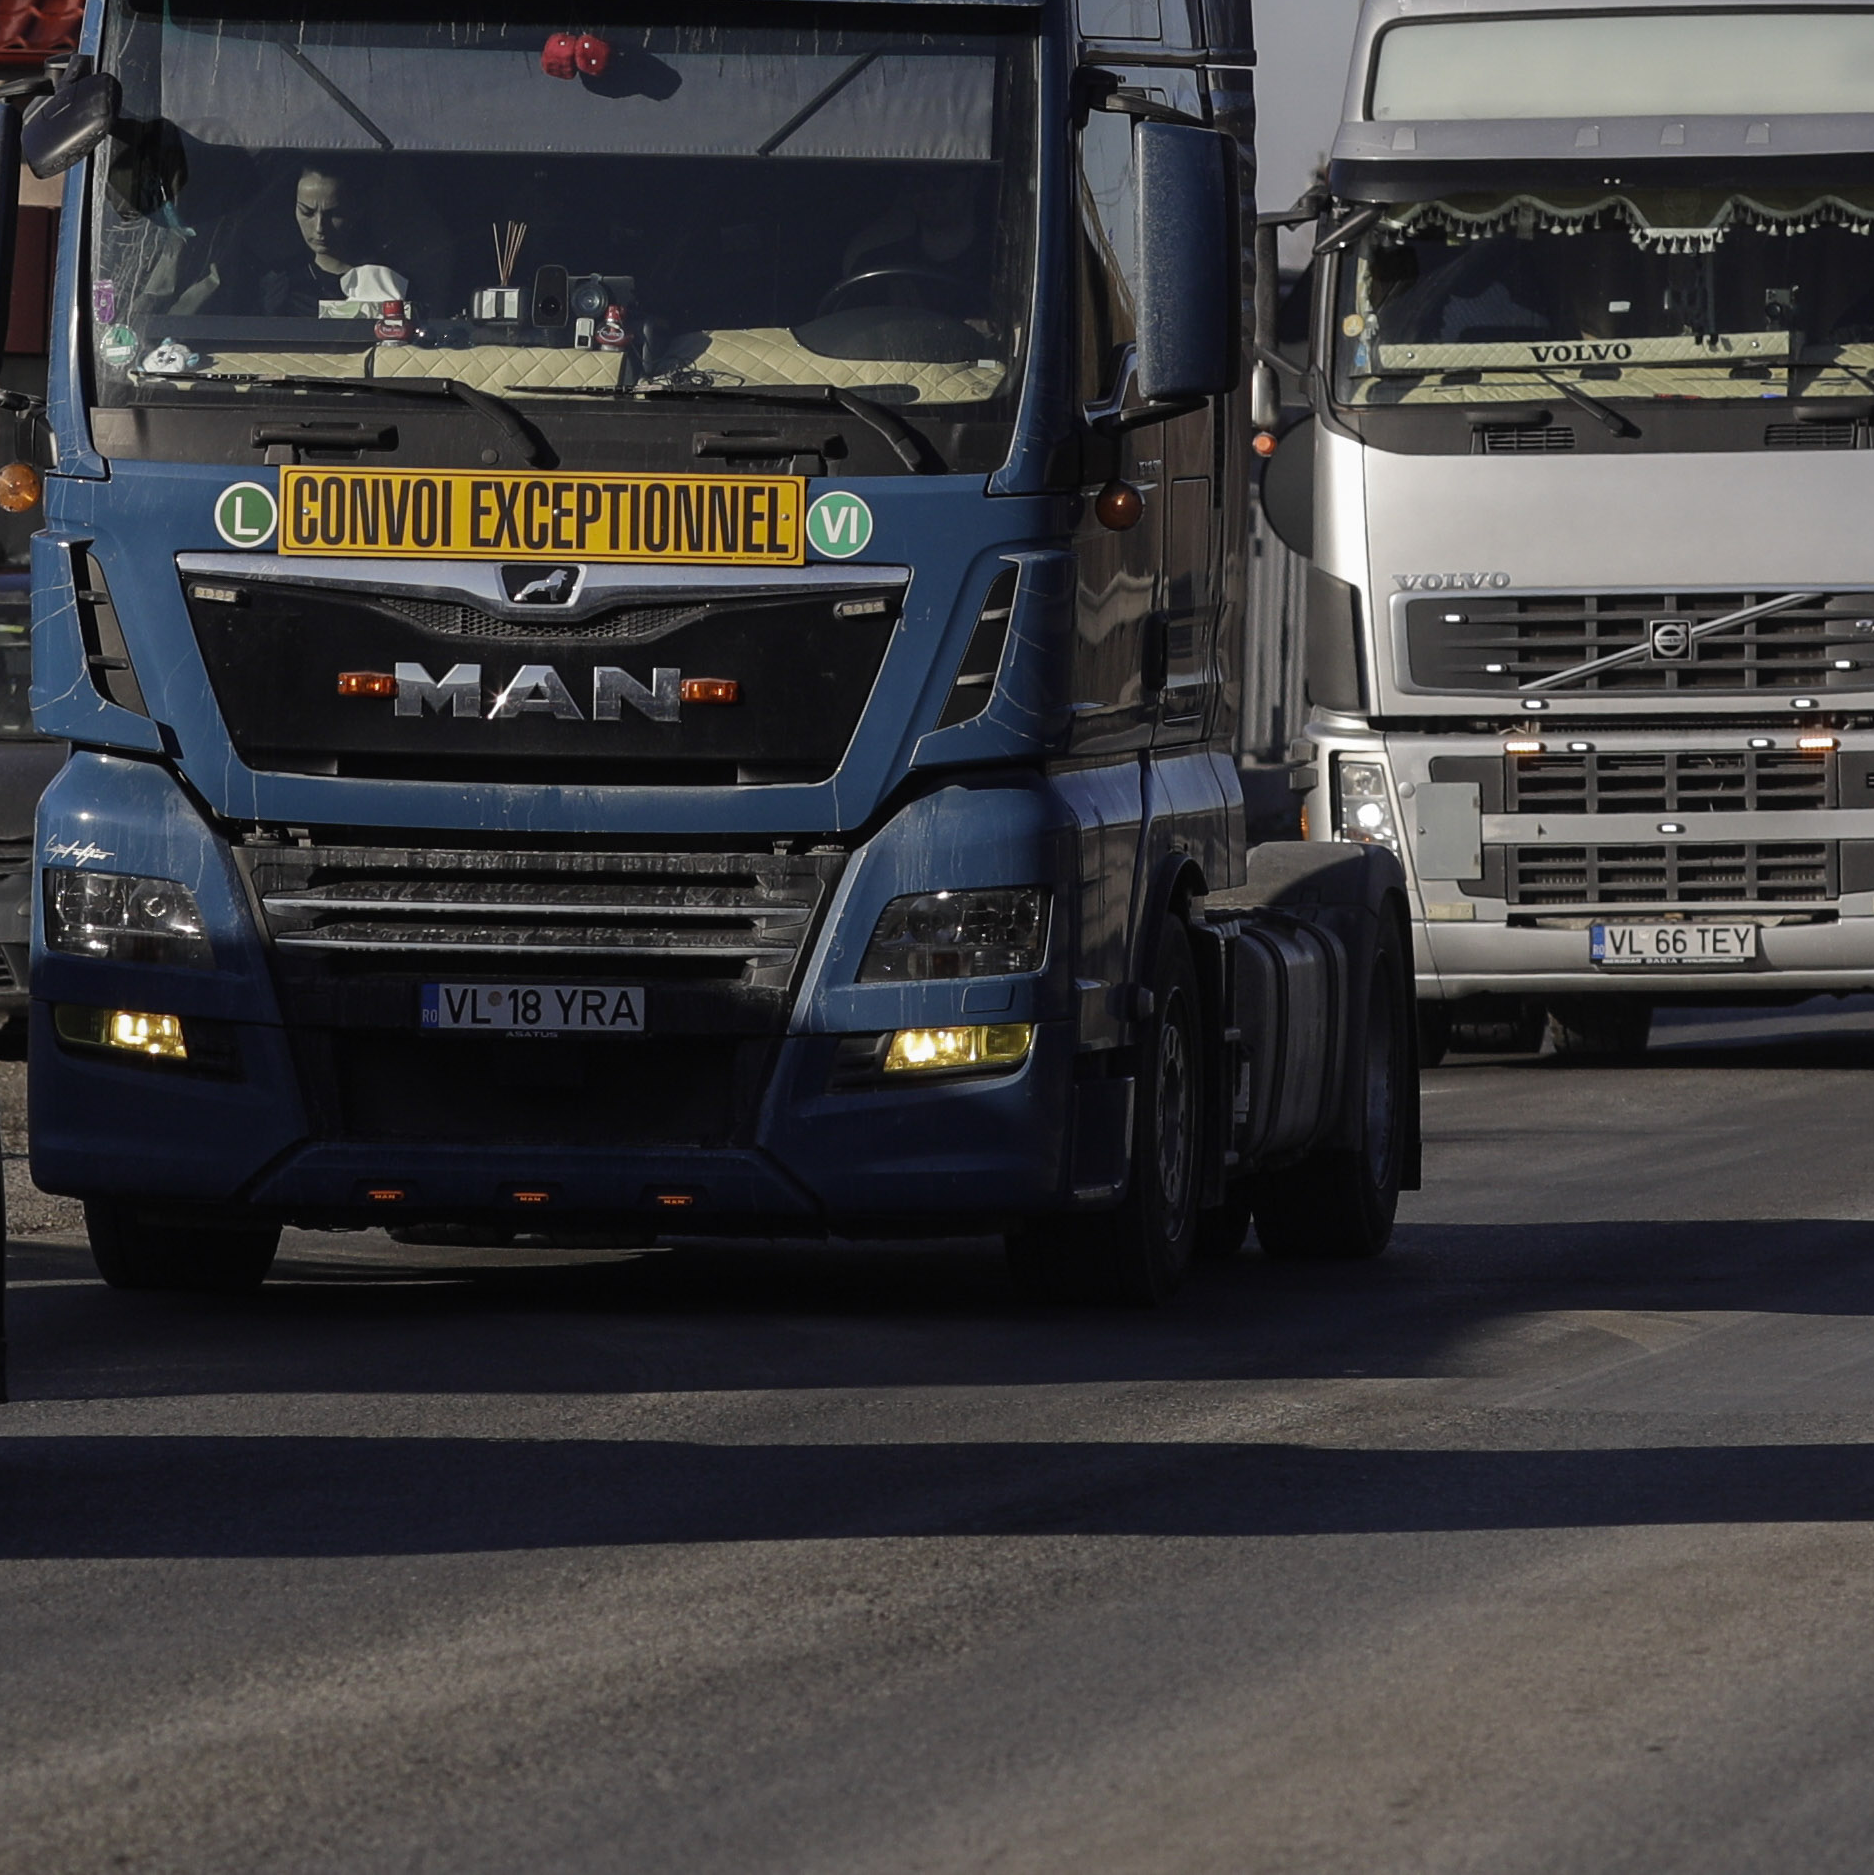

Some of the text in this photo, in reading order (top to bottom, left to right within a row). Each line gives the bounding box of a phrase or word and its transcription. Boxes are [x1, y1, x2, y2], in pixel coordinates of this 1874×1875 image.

[1531, 343, 1633, 363] VOLVO
[234, 496, 260, 536] L
[293, 475, 789, 555] CONVOI EXCEPTIONNEL
[820, 505, 859, 544] VI
[1392, 571, 1511, 590] VOLVO
[394, 662, 681, 721] MAN
[1592, 944, 1605, 955] RO
[1609, 927, 1751, 955] VL 66 TEY
[422, 1008, 438, 1023] RO
[444, 987, 638, 1026] VL 18 YRA
